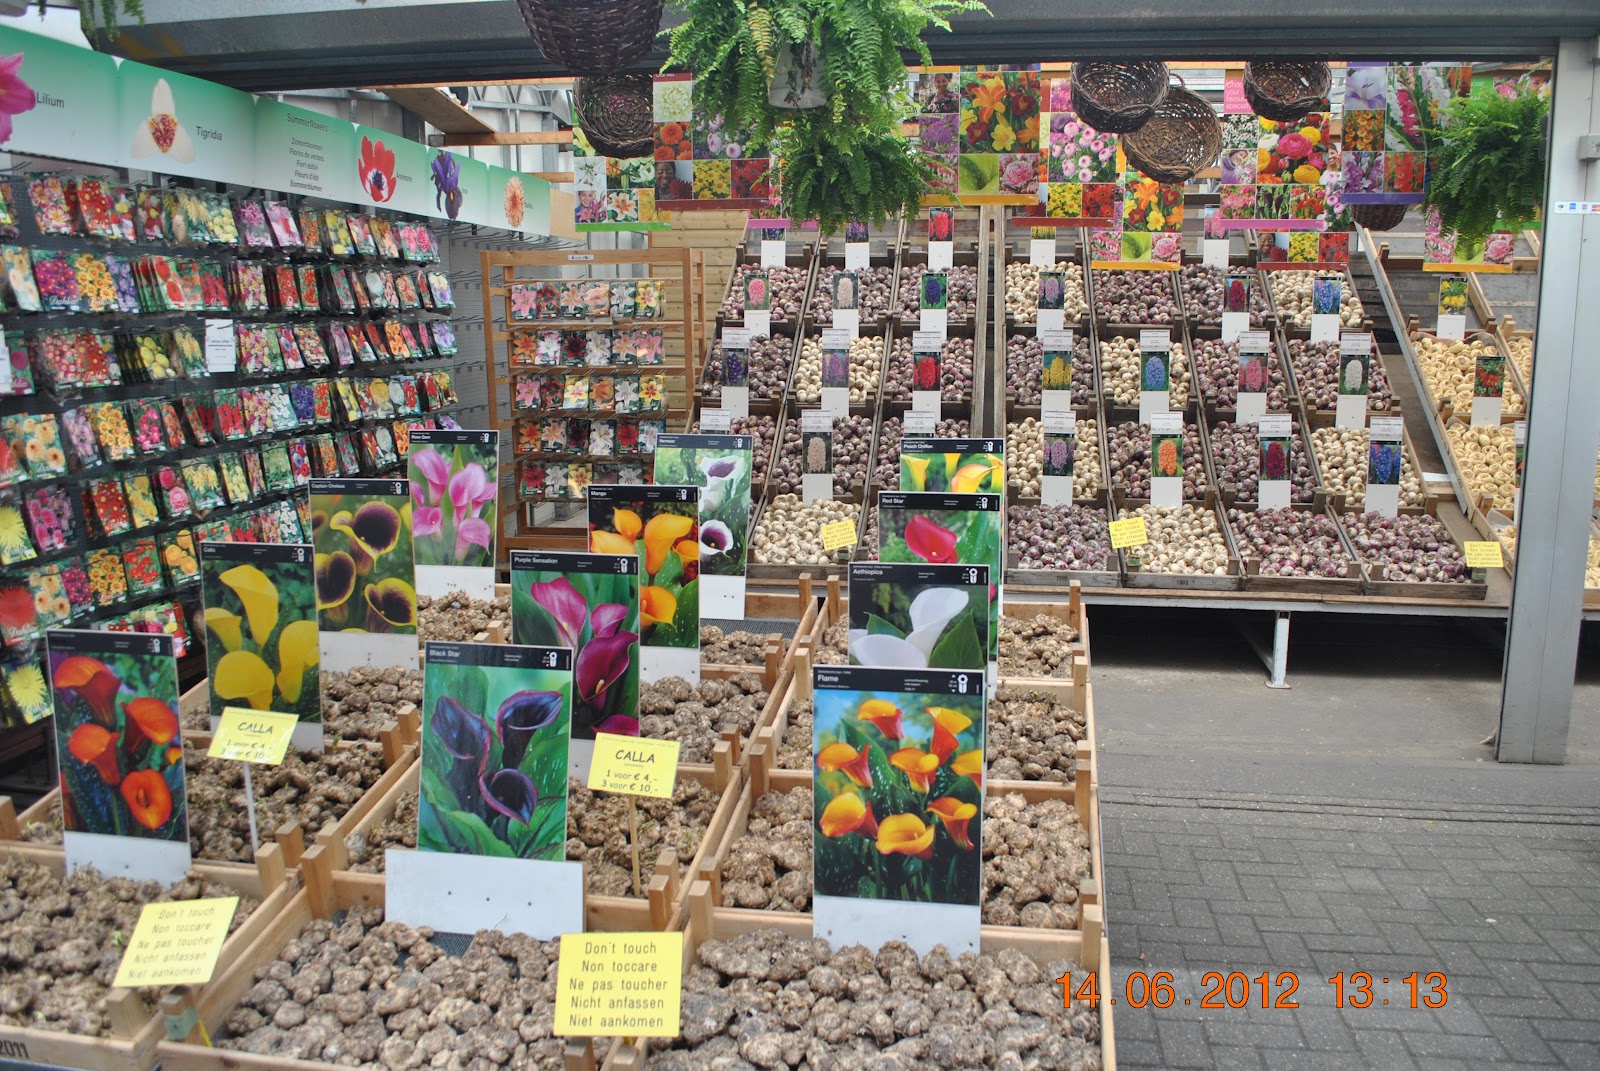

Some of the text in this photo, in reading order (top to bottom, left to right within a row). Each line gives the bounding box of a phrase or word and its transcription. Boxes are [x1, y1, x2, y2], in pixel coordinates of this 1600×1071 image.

[36, 92, 65, 108] Lilium
[287, 113, 328, 132] Summerflowers
[196, 126, 222, 141] Tigridia
[291, 138, 323, 151] Zomerbloemen
[290, 148, 303, 157] Flores
[295, 170, 308, 179] Fleurs
[290, 180, 322, 192] Sommerblumen
[49, 296, 78, 305] Dahlia
[9, 625, 37, 637] Dahlia
[429, 649, 446, 657] Black
[817, 674, 839, 682] Flame
[238, 722, 273, 734] CALLA
[615, 750, 655, 764] CALLA
[606, 769, 611, 777] 1
[614, 772, 632, 780] voor
[634, 773, 641, 781] €
[601, 779, 607, 787] 3
[609, 782, 627, 790] voor
[159, 907, 215, 919] Don't touch
[151, 922, 211, 934] Non toccare
[138, 937, 214, 950] Ne pas toucher
[585, 941, 656, 954] Don't touch
[134, 952, 207, 964] Nicht anfassen
[581, 960, 657, 972] Non toccare
[128, 967, 201, 979] Niet aankomen
[569, 978, 667, 993] Ne pas toucher
[571, 996, 664, 1009] Nicht anfassen
[569, 1014, 664, 1027] Niet aankomen
